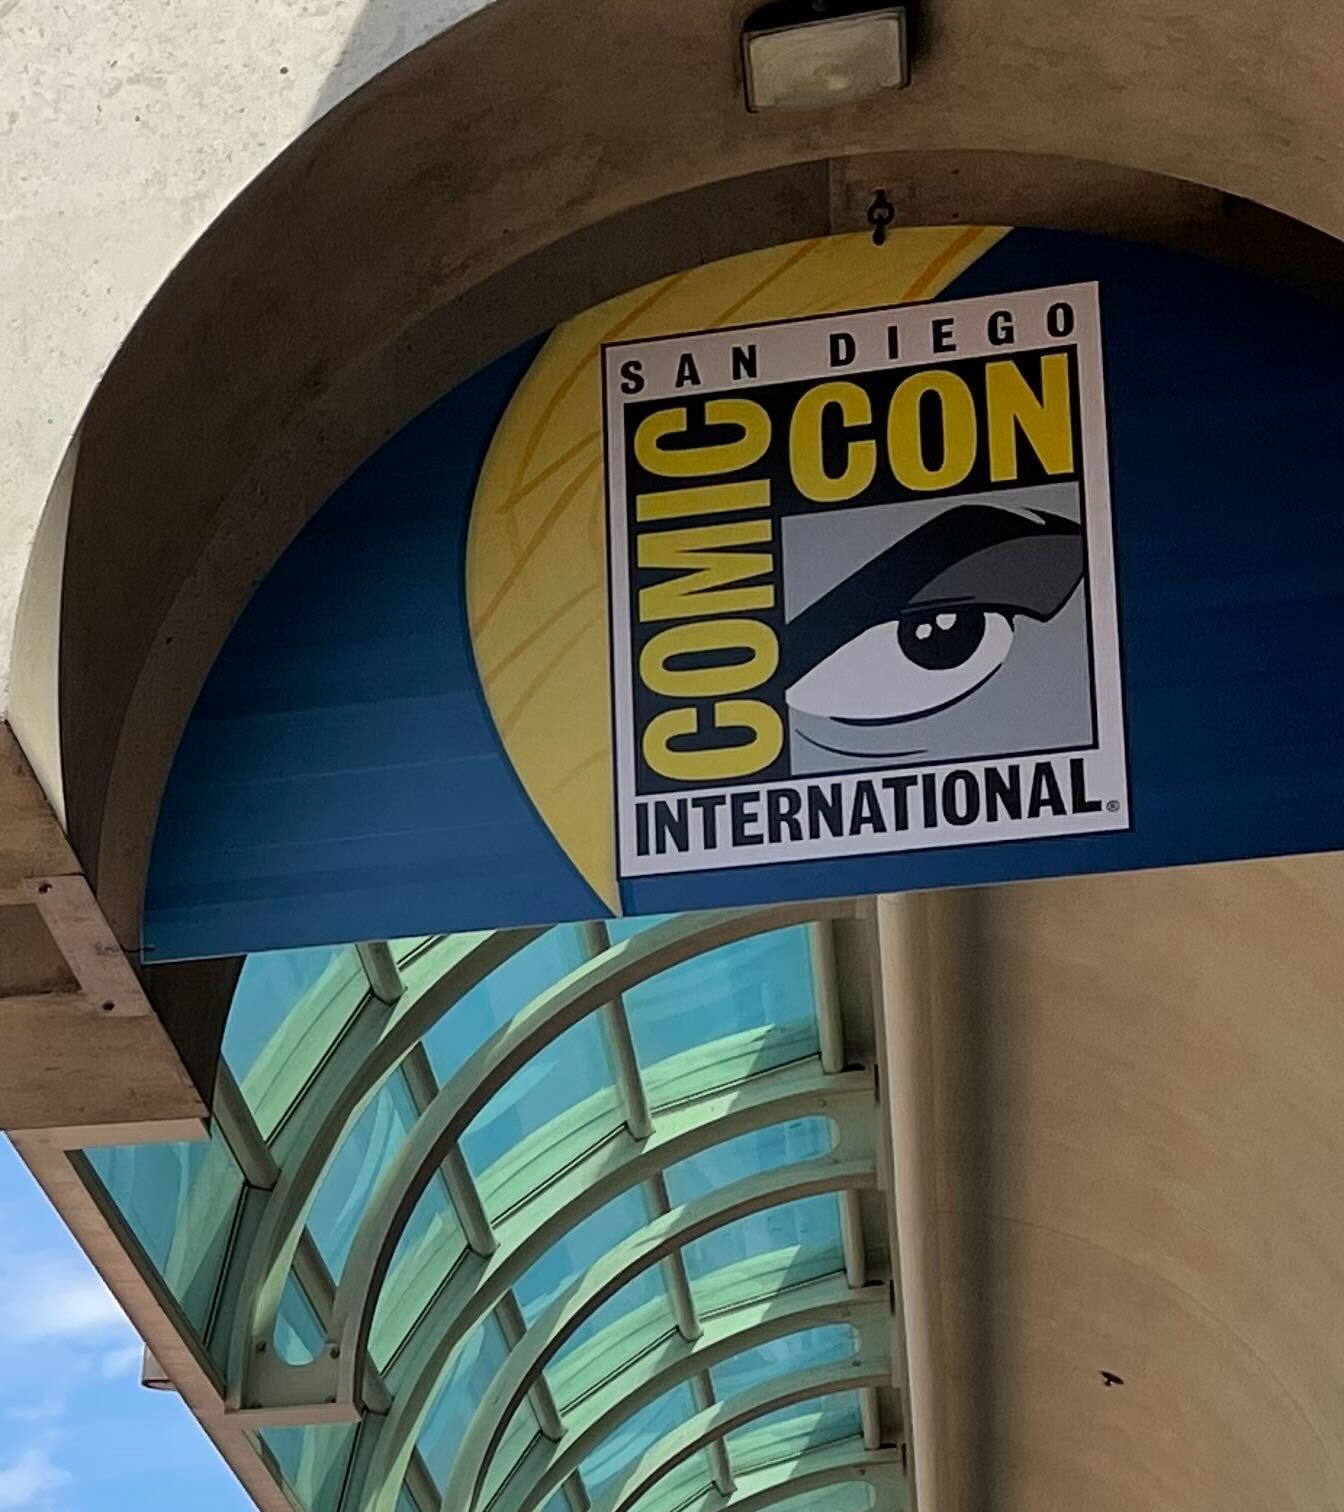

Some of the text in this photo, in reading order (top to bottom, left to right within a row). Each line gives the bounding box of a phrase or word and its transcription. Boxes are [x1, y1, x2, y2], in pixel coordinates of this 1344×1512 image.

[620, 301, 1075, 394] SAN DIEGO
[789, 353, 1074, 504] CON
[634, 398, 784, 782] COMIC
[635, 758, 1106, 857] INTERNATIONAL
